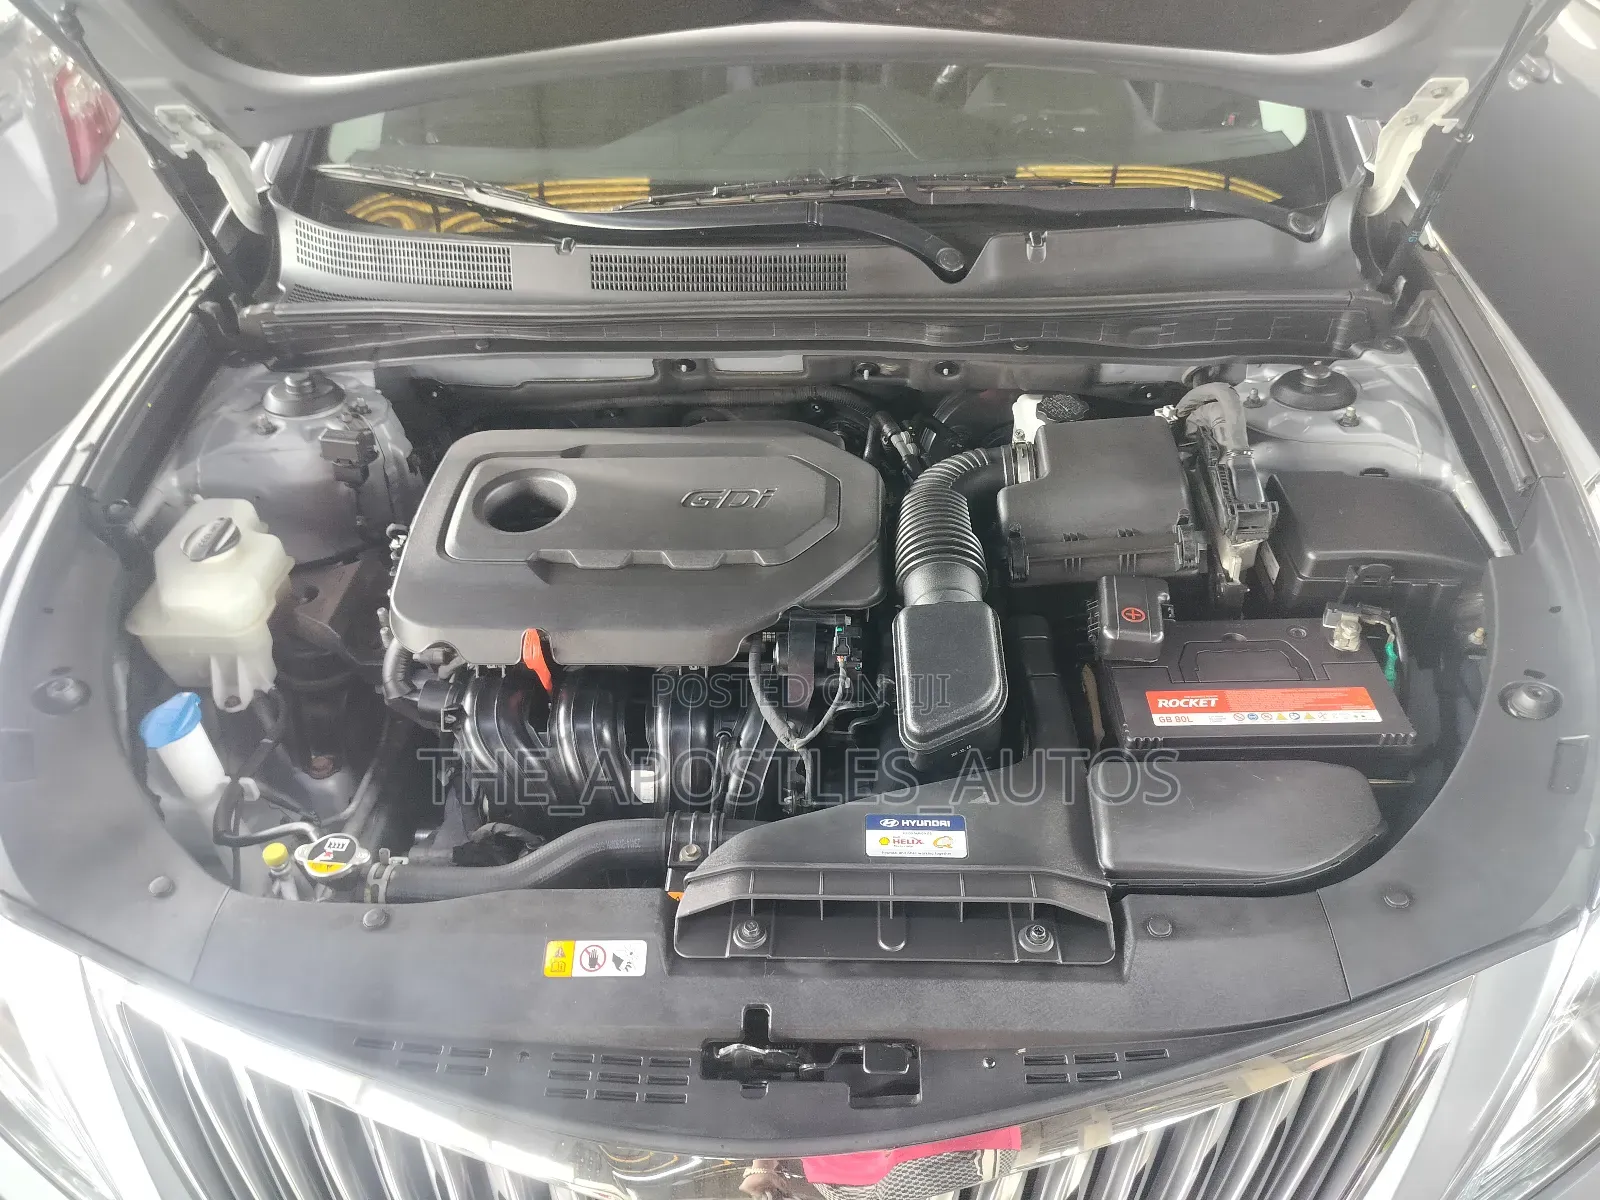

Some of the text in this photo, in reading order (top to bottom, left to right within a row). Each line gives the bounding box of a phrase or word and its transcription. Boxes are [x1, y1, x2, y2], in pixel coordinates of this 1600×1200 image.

[680, 486, 778, 508] GDi
[1156, 698, 1219, 708] ROCKET
[901, 819, 951, 828] HYUNDAI
